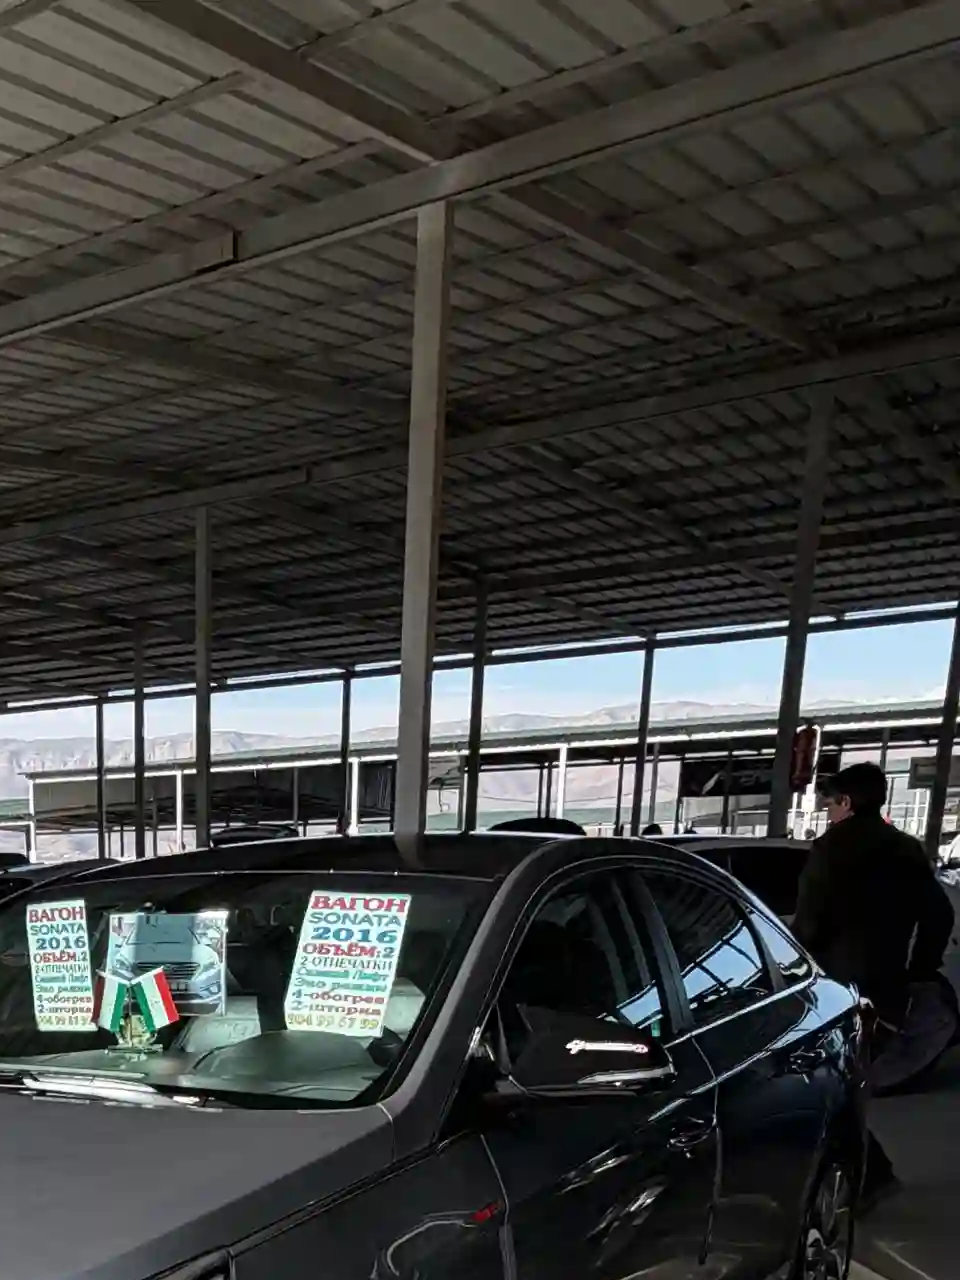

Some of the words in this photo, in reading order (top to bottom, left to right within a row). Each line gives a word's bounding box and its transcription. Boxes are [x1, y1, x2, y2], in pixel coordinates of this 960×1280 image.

[311, 895, 409, 913] ВАГОН
[29, 906, 85, 923] ВАГОН
[308, 912, 402, 927] SONATA
[30, 923, 86, 936] SONATA
[311, 927, 398, 943] 2016
[36, 936, 86, 949] 2016
